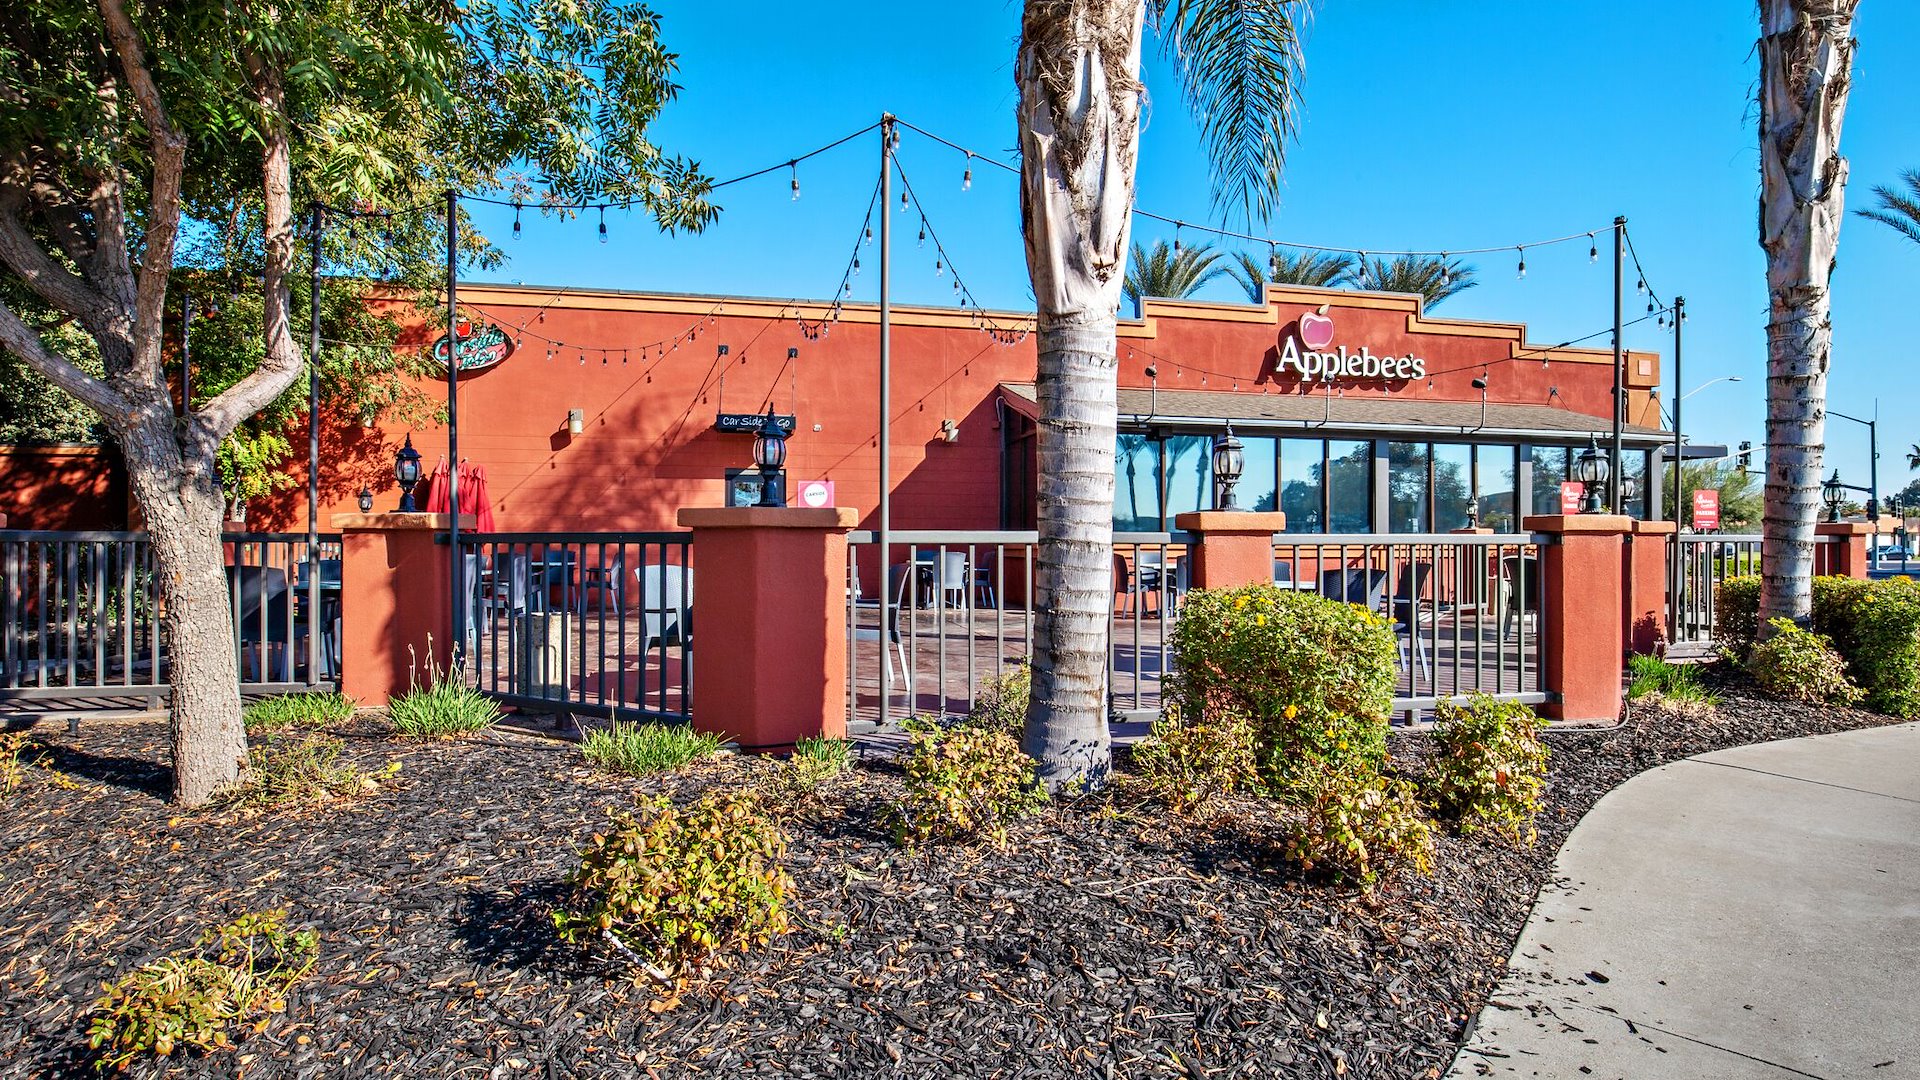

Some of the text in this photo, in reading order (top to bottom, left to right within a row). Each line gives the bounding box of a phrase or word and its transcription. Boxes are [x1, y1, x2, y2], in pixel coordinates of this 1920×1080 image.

[1276, 335, 1426, 382] Applebee's
[723, 417, 740, 426] Car
[740, 416, 763, 426] Side
[776, 418, 791, 429] Go
